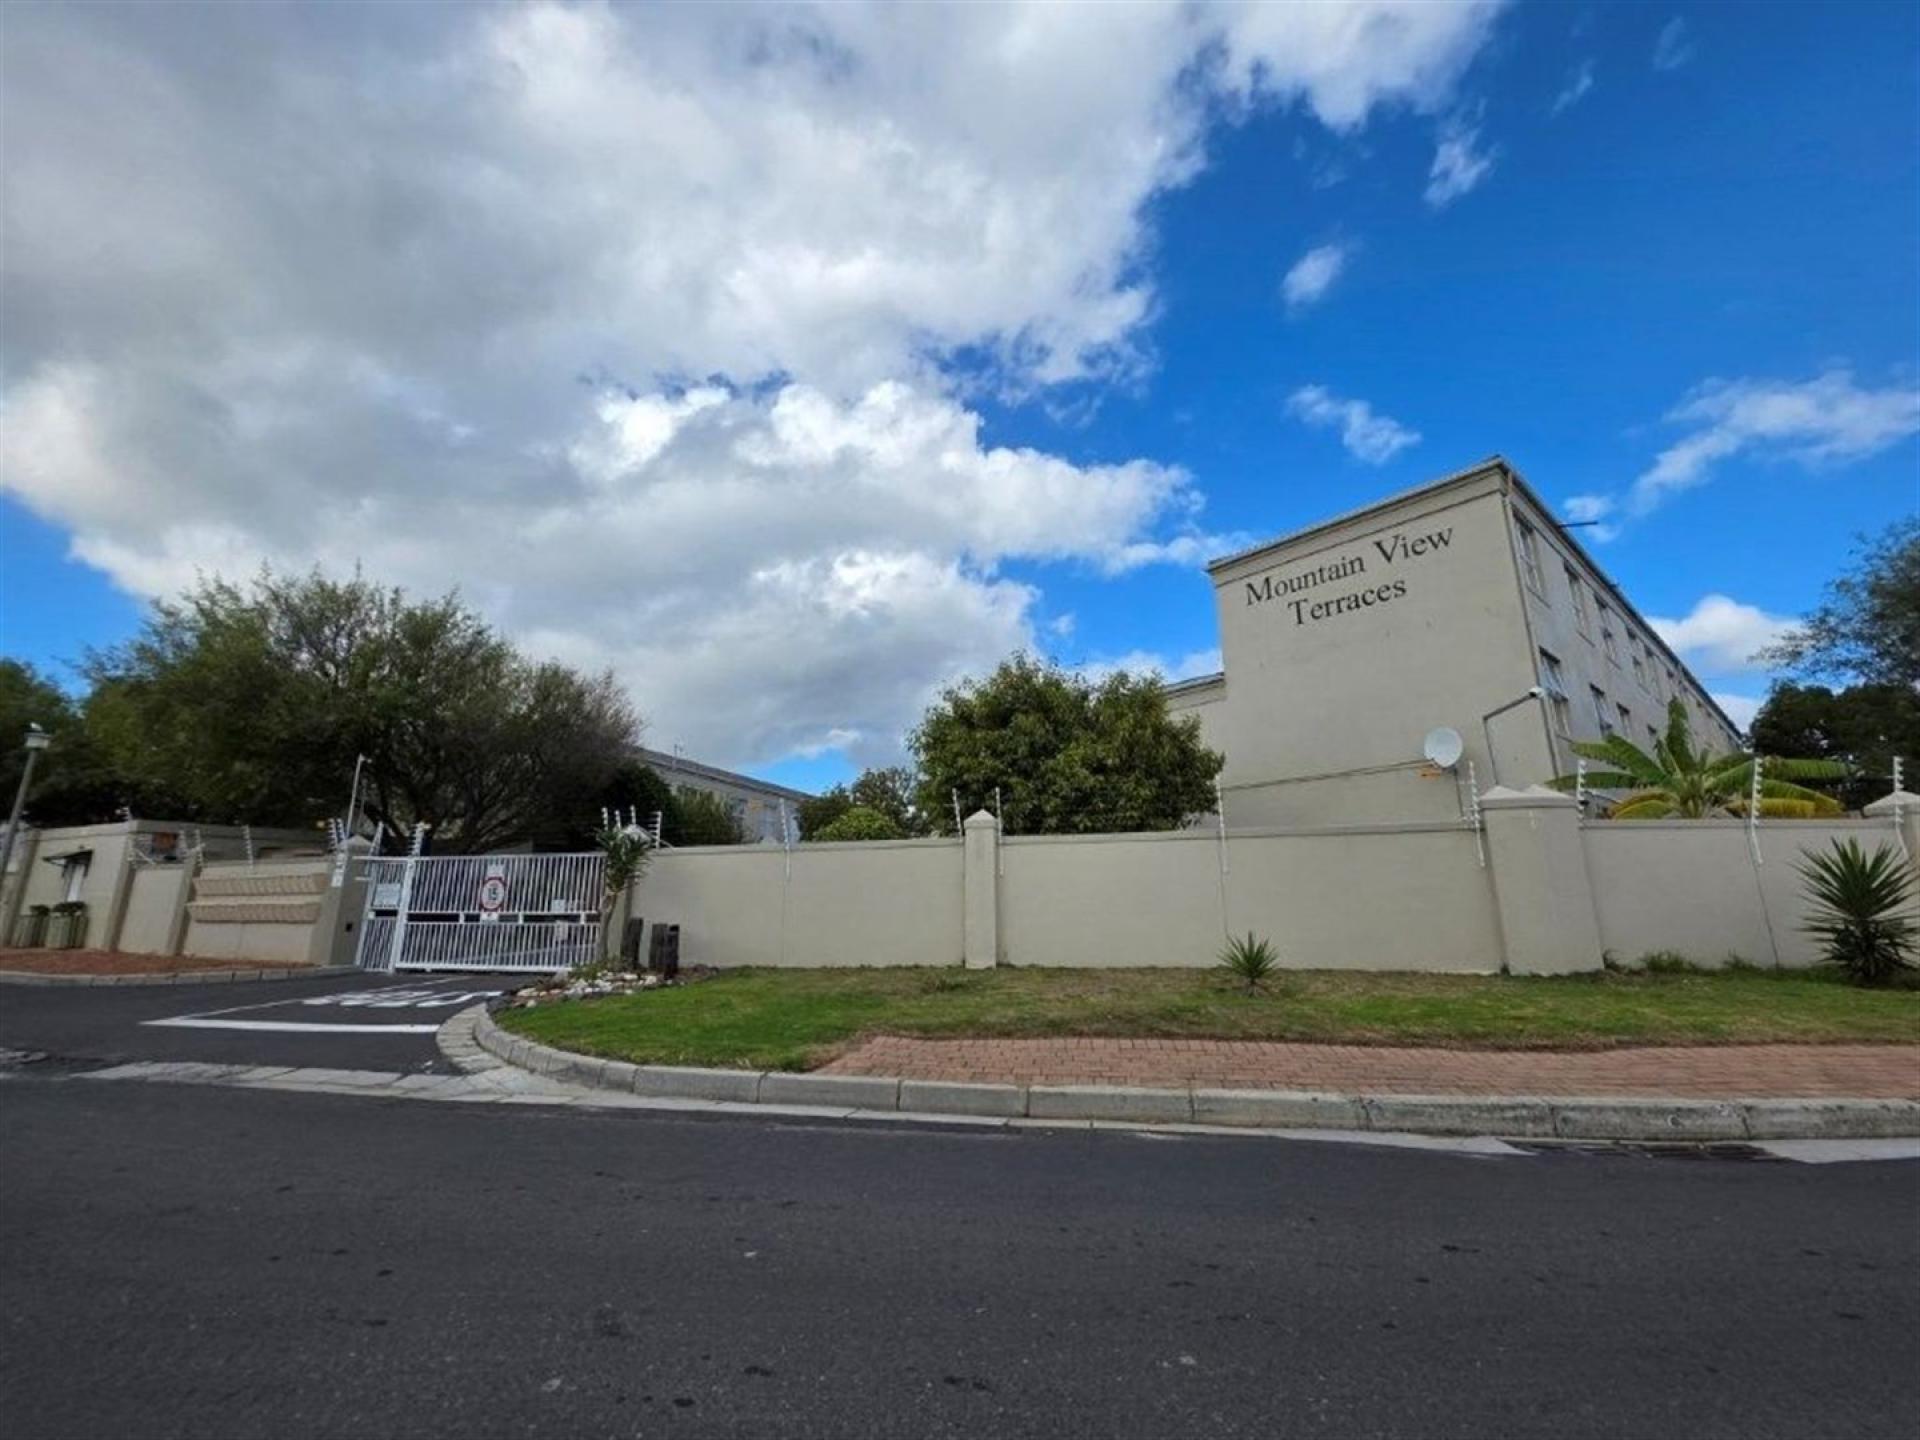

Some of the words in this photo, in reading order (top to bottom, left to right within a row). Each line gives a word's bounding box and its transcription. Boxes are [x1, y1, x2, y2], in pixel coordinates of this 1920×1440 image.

[1246, 556, 1366, 605] Mountain
[1374, 528, 1453, 564] View
[1288, 580, 1407, 625] Terraces
